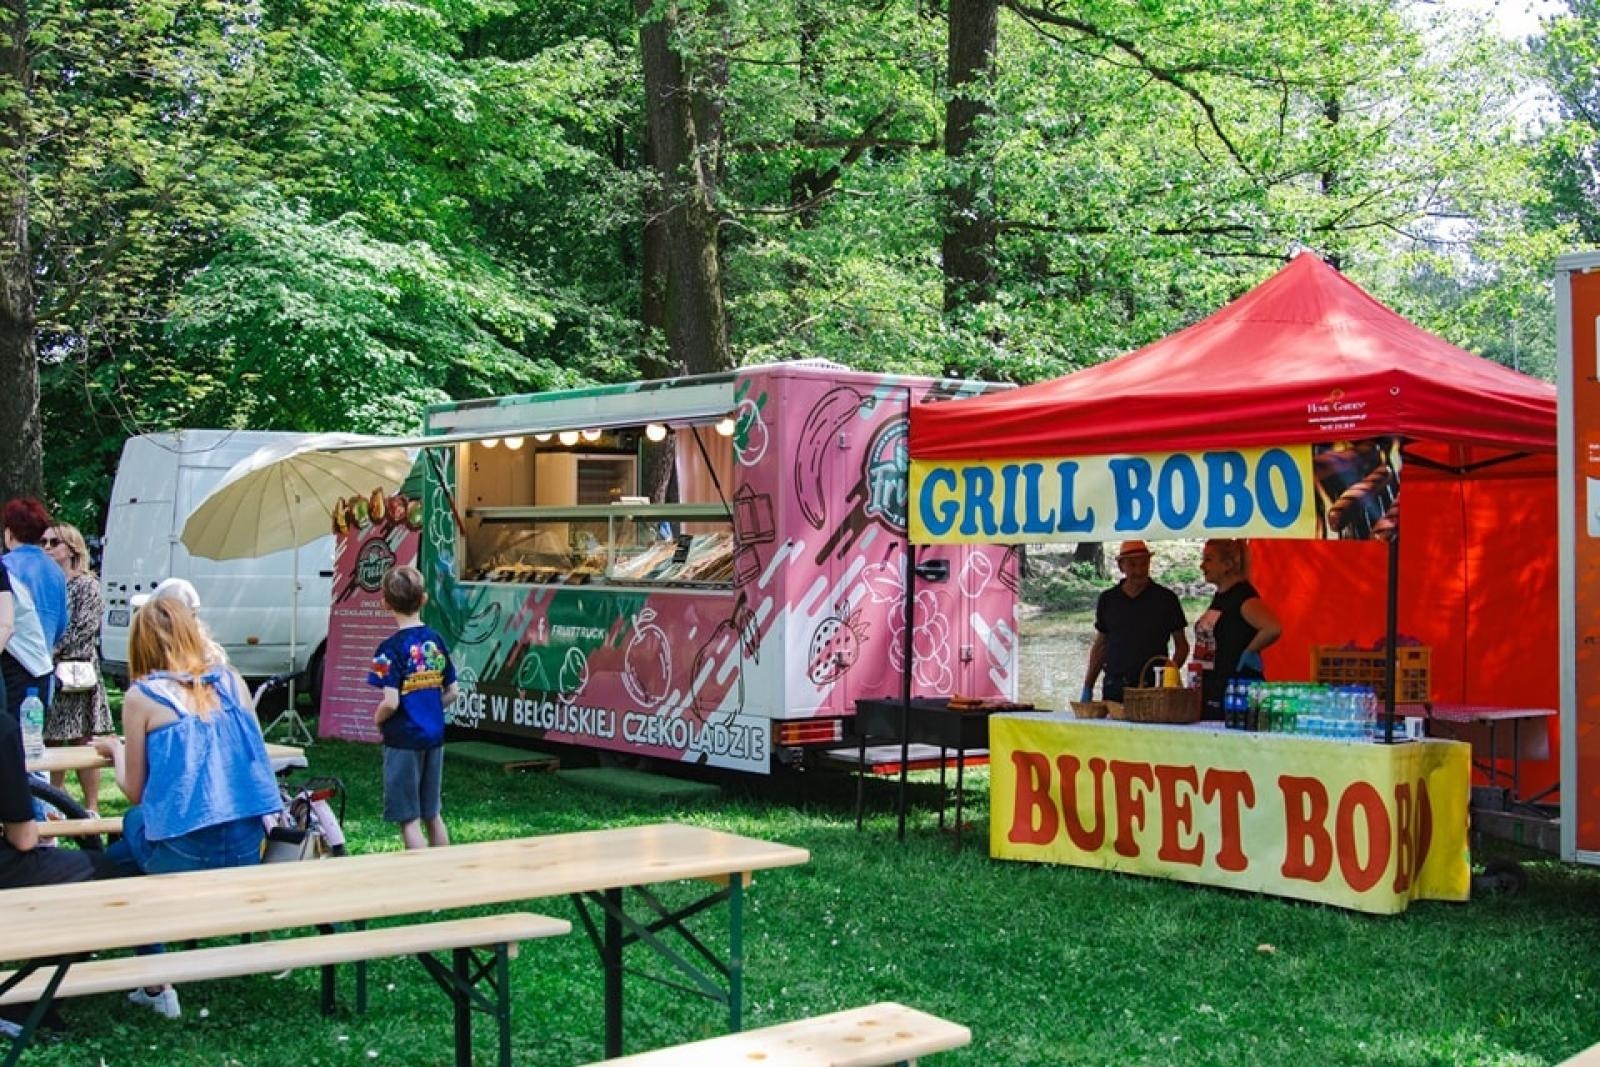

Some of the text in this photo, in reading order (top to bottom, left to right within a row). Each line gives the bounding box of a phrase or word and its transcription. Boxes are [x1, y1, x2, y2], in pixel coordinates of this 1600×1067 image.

[919, 448, 1304, 536] GRILL BOBO
[491, 695, 508, 723] W
[513, 698, 616, 740] BELGIJSKIEJ
[1007, 750, 1256, 872] BUFET
